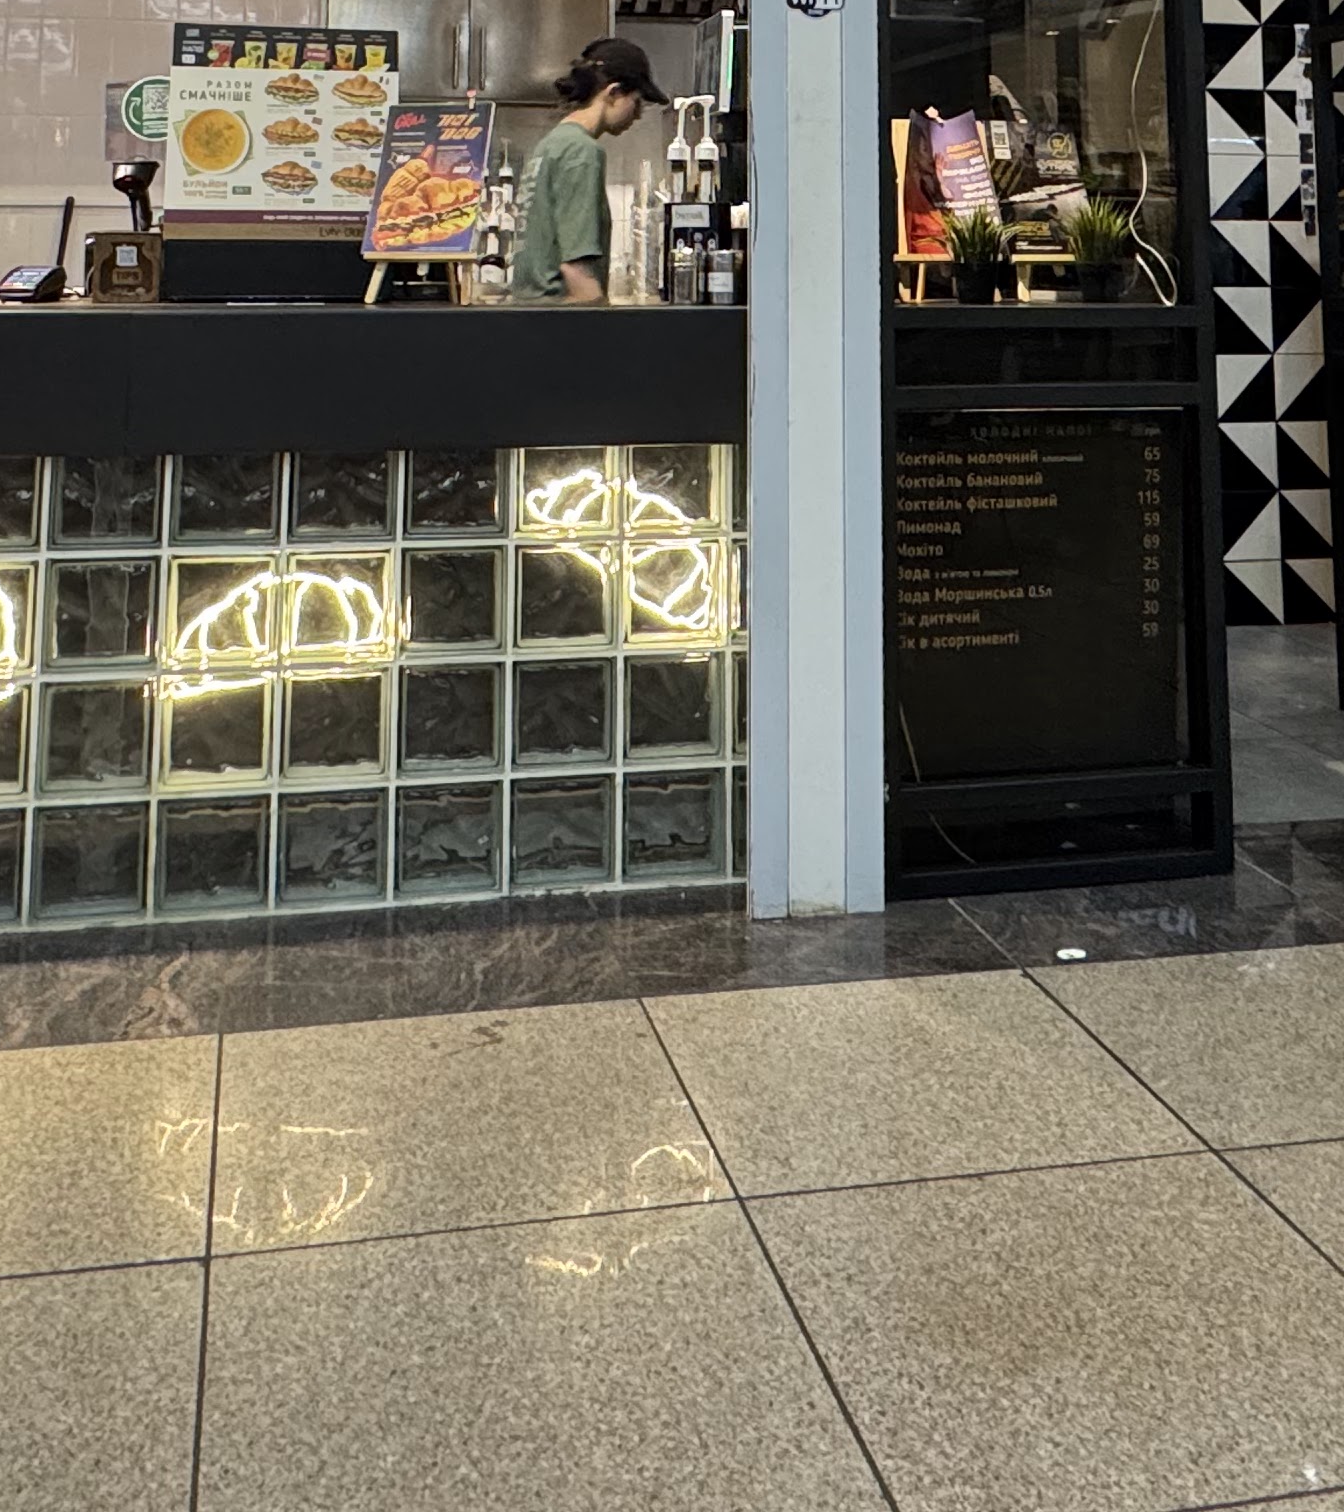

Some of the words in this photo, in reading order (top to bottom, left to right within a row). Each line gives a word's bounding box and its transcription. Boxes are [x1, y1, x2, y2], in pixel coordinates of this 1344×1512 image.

[206, 80, 252, 89] РАЗОМ
[179, 90, 252, 102] СМАЧНІШЕ
[896, 451, 962, 467] Коктейль
[967, 449, 1039, 464] молочний
[1143, 446, 1160, 461] 65
[896, 474, 962, 489] Коктейль
[967, 471, 1043, 486] банановий
[1144, 468, 1160, 483] 75
[896, 496, 962, 512] Коктейль
[966, 492, 1057, 513] фісташковий
[1137, 490, 1160, 505] 115
[1143, 512, 1160, 527] 59
[1143, 556, 1159, 571] 25
[1143, 578, 1159, 593] 30
[1142, 600, 1159, 615] 30
